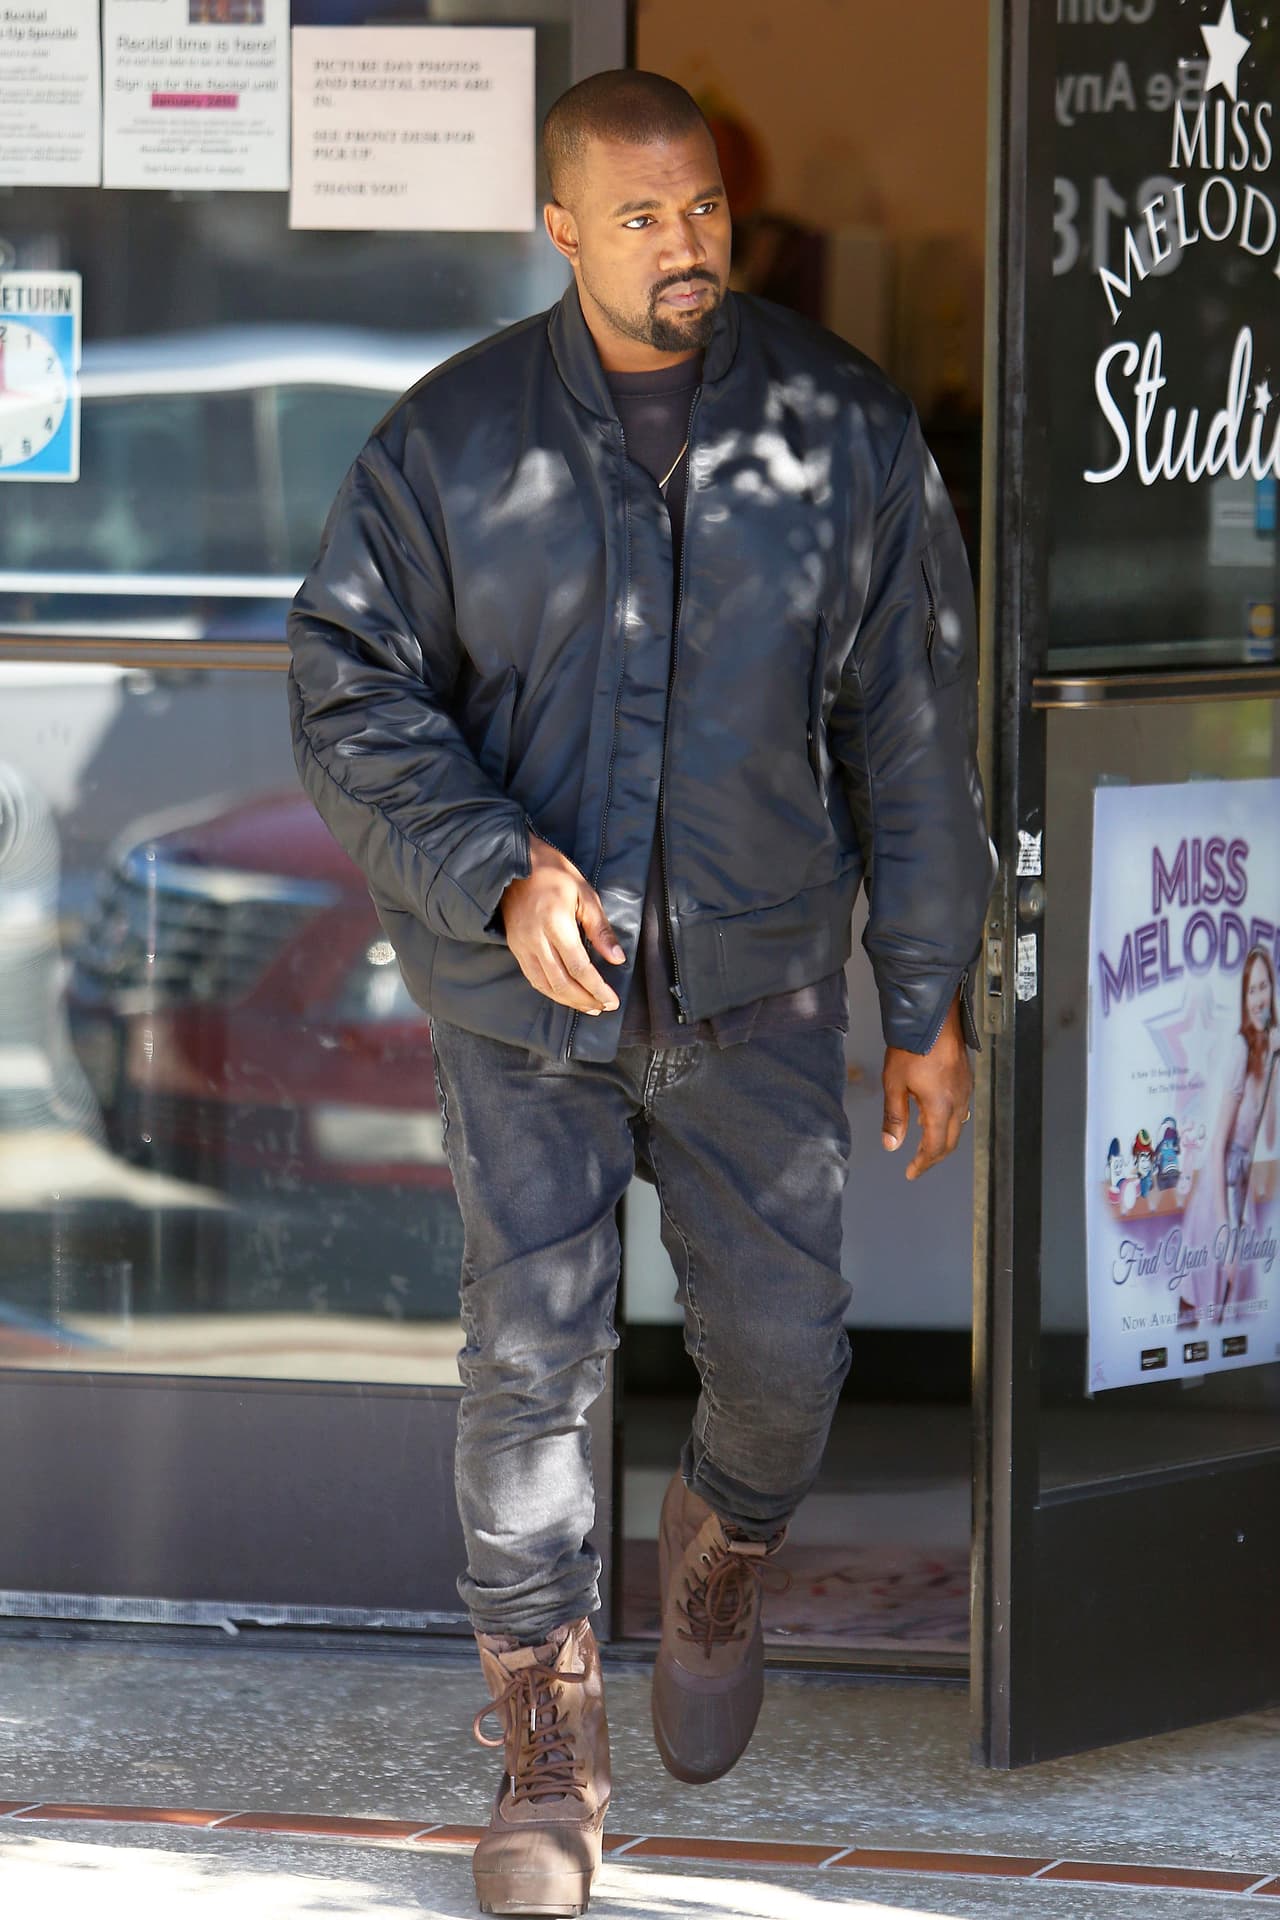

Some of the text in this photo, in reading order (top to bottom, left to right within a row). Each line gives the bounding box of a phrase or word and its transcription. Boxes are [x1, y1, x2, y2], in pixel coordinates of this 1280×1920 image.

[116, 36, 173, 52] Recital
[178, 37, 209, 51] time
[216, 39, 229, 51] is
[313, 60, 377, 74] PICTURE
[418, 60, 480, 74] PHOTOS
[314, 78, 347, 91] AND
[351, 78, 413, 91] RECITAL
[400, 130, 441, 143] DESK
[1169, 99, 1272, 172] MISS
[1099, 176, 1280, 325] MELOD
[1083, 325, 1280, 486] Studi
[1152, 836, 1249, 916] MISS
[1099, 909, 1280, 1019] MELODE
[1112, 1223, 1277, 1291] Find Your Melody
